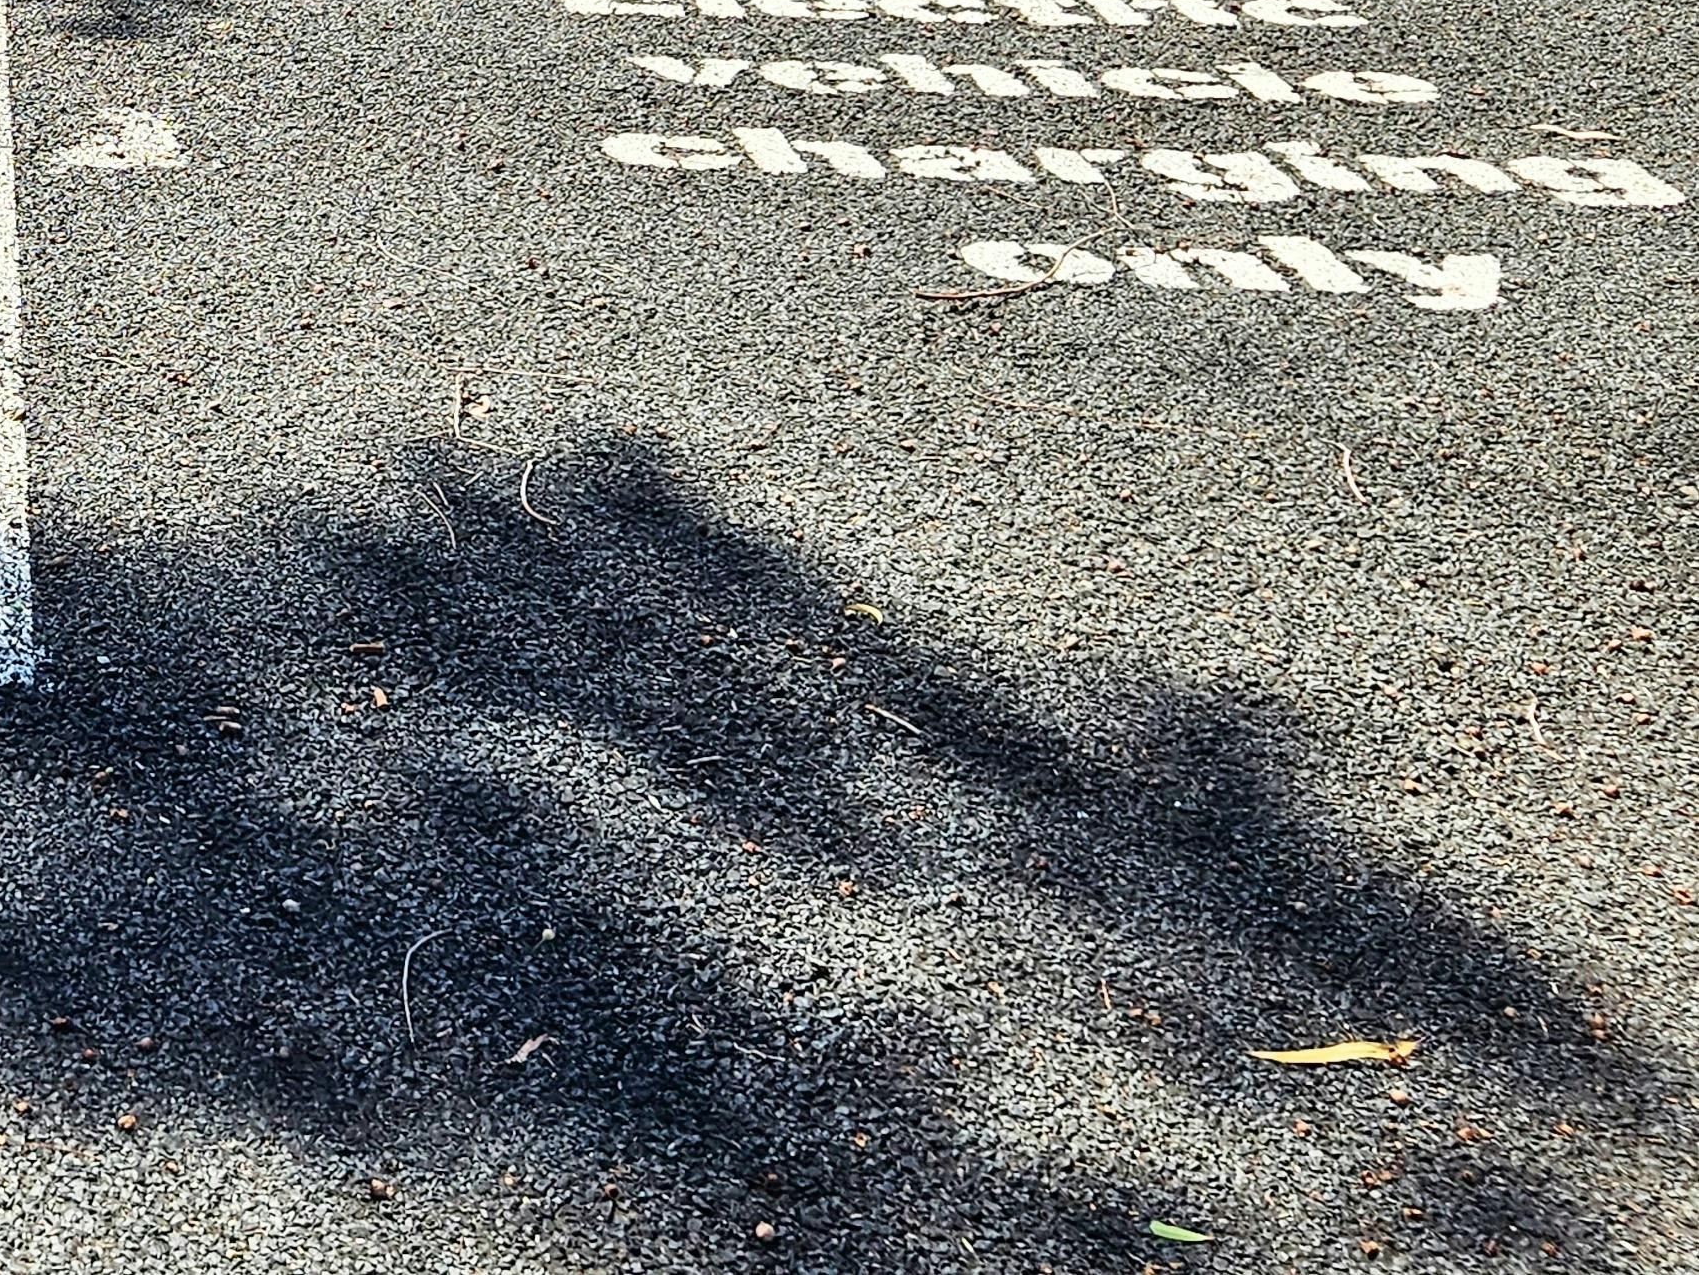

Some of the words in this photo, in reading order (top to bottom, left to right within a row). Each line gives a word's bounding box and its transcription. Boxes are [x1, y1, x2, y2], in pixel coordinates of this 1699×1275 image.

[626, 53, 1440, 103] vehicle
[601, 126, 1687, 207] charging
[958, 234, 1502, 312] only
